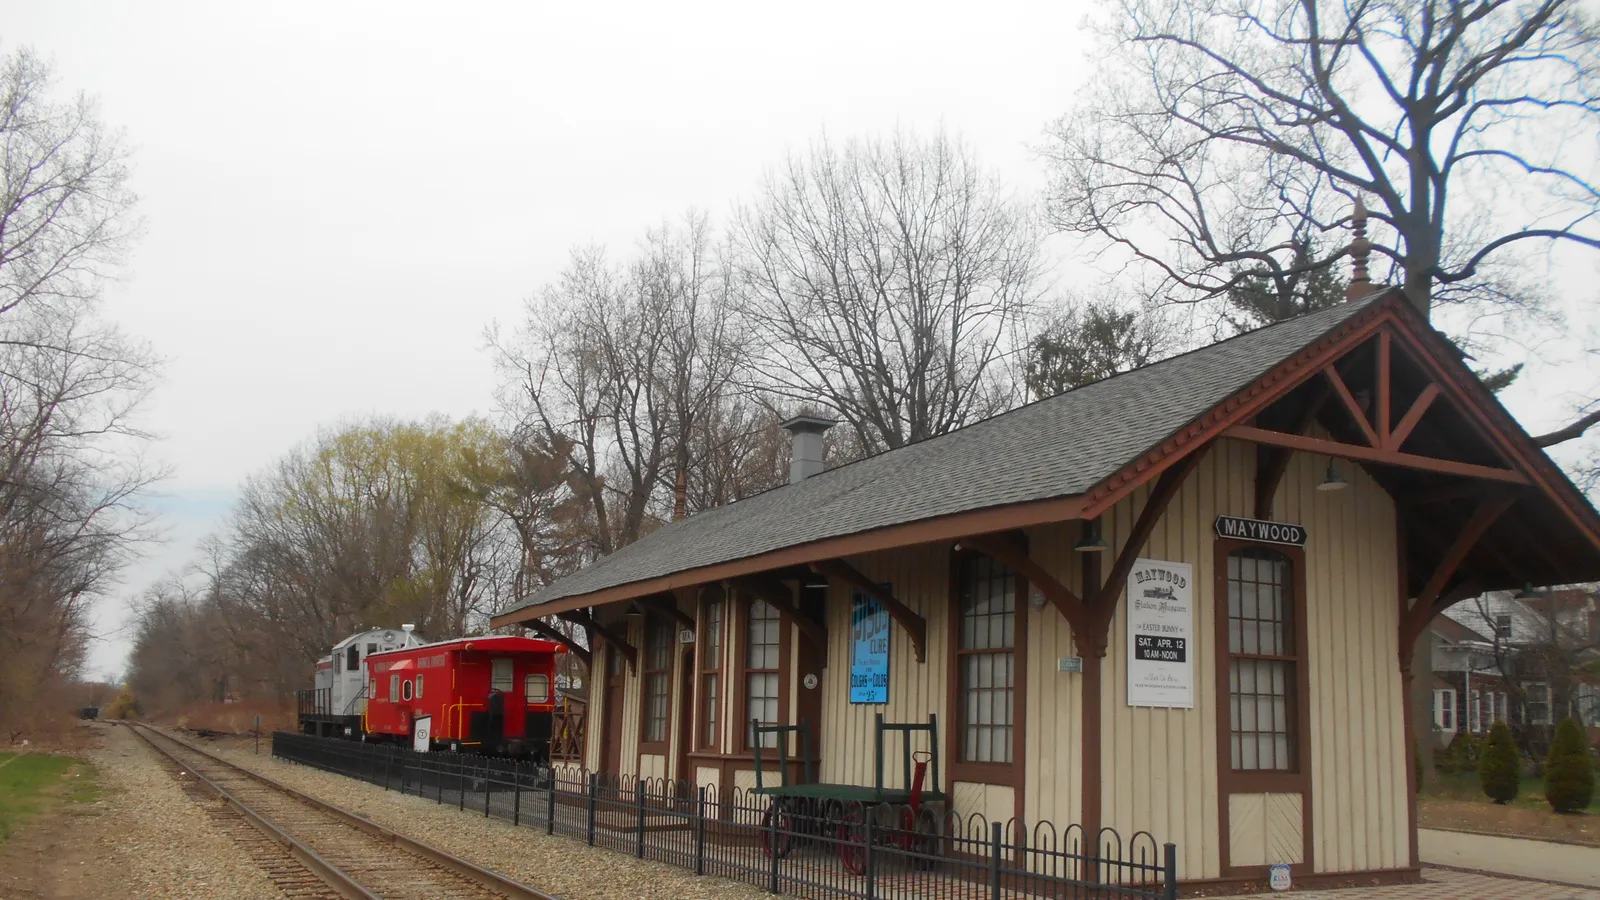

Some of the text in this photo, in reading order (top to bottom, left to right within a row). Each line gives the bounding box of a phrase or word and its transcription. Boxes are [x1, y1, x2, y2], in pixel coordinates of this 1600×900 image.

[1224, 518, 1300, 543] MAYWOOD
[1135, 568, 1187, 589] MAYWOOD
[1134, 599, 1187, 614] Station Museum
[1142, 623, 1179, 633] EASTER BUNNY
[870, 638, 887, 655] CURE
[1138, 637, 1184, 649] SAT. APR. 12
[873, 673, 887, 687] COLDS
